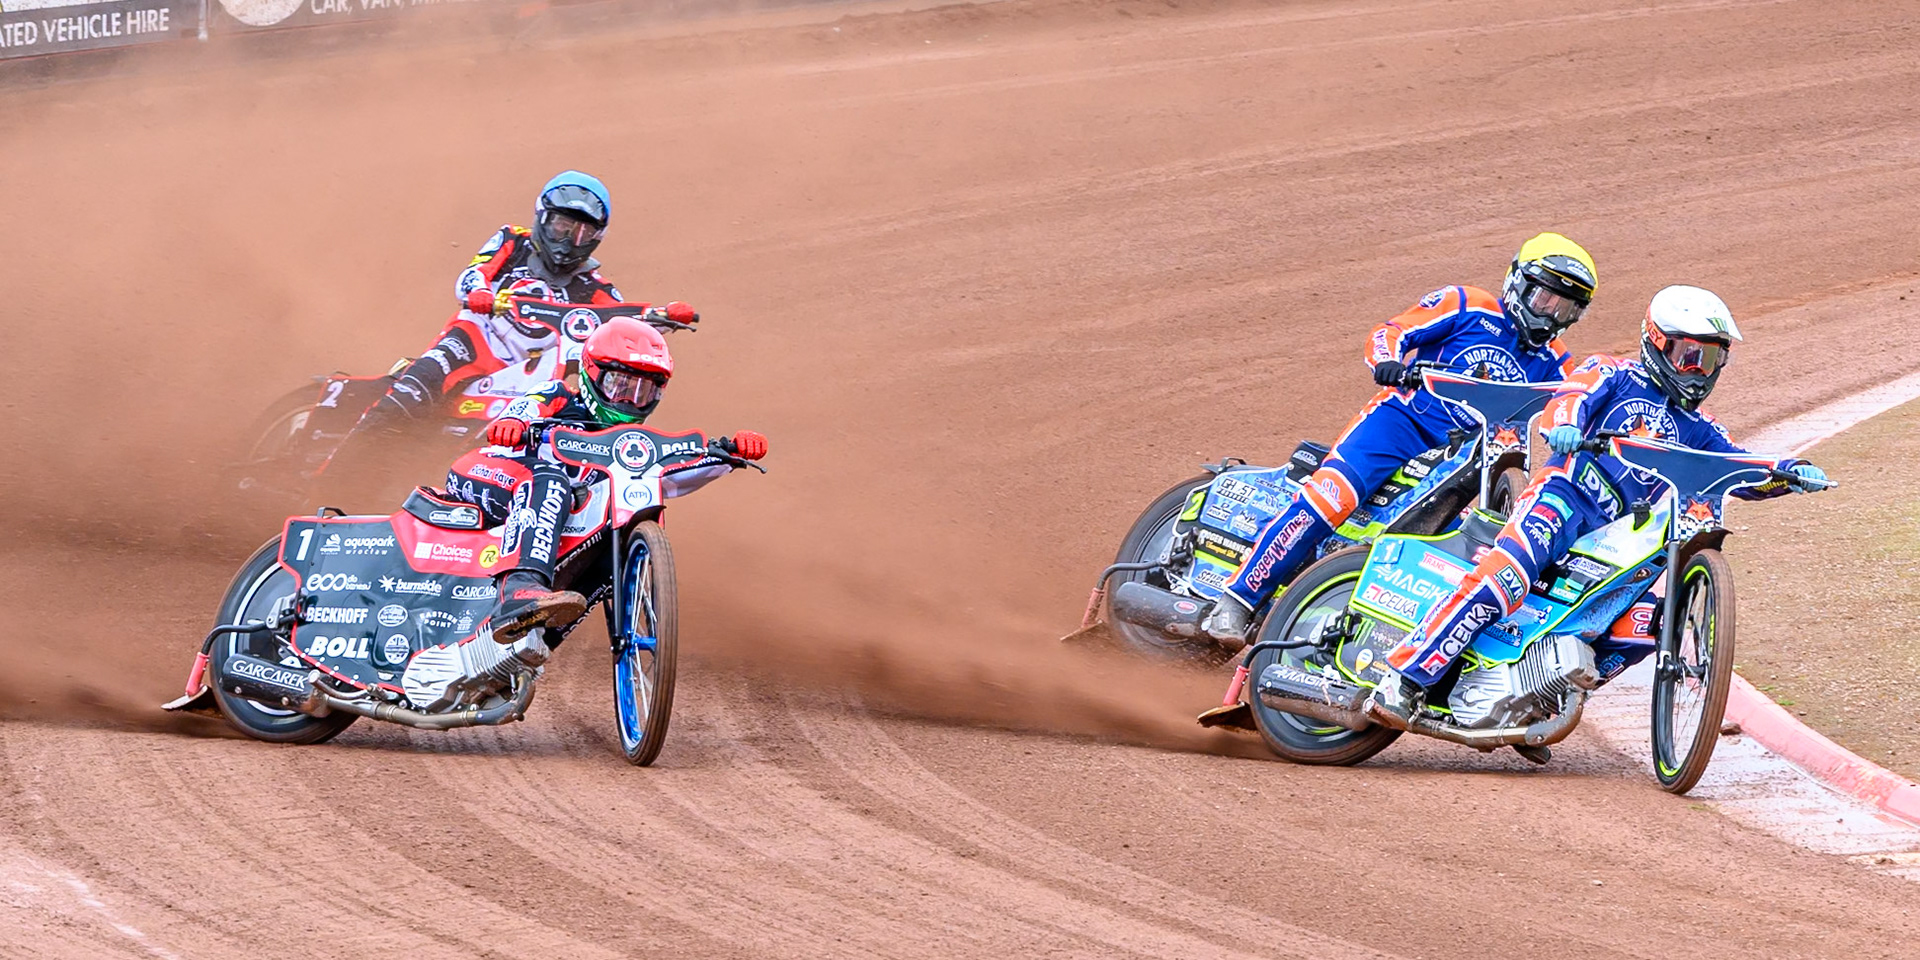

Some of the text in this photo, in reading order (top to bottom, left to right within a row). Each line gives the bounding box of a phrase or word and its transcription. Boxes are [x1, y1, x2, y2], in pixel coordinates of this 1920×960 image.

[42, 13, 121, 42] VEHICLE
[126, 8, 170, 34] HIRE
[1464, 349, 1524, 383] NORTHAMPT
[321, 380, 344, 408] 2
[557, 439, 611, 456] GARCAREK
[628, 490, 648, 499] ATPI
[1583, 468, 1618, 521] DVR
[1181, 491, 1206, 521] 2
[530, 480, 568, 564] BECKHOFF
[296, 528, 314, 561] 1
[344, 535, 395, 550] aquapark
[432, 543, 473, 558] Choices
[1383, 542, 1396, 562] 1
[306, 573, 347, 592] eco
[396, 579, 442, 594] burnside
[1501, 567, 1526, 600] DVR
[306, 607, 369, 624] BECKHOFF
[420, 611, 458, 626] EASTERN
[424, 619, 452, 629] POINT
[308, 636, 370, 660] BOLL
[232, 659, 309, 690] GARCAREK
